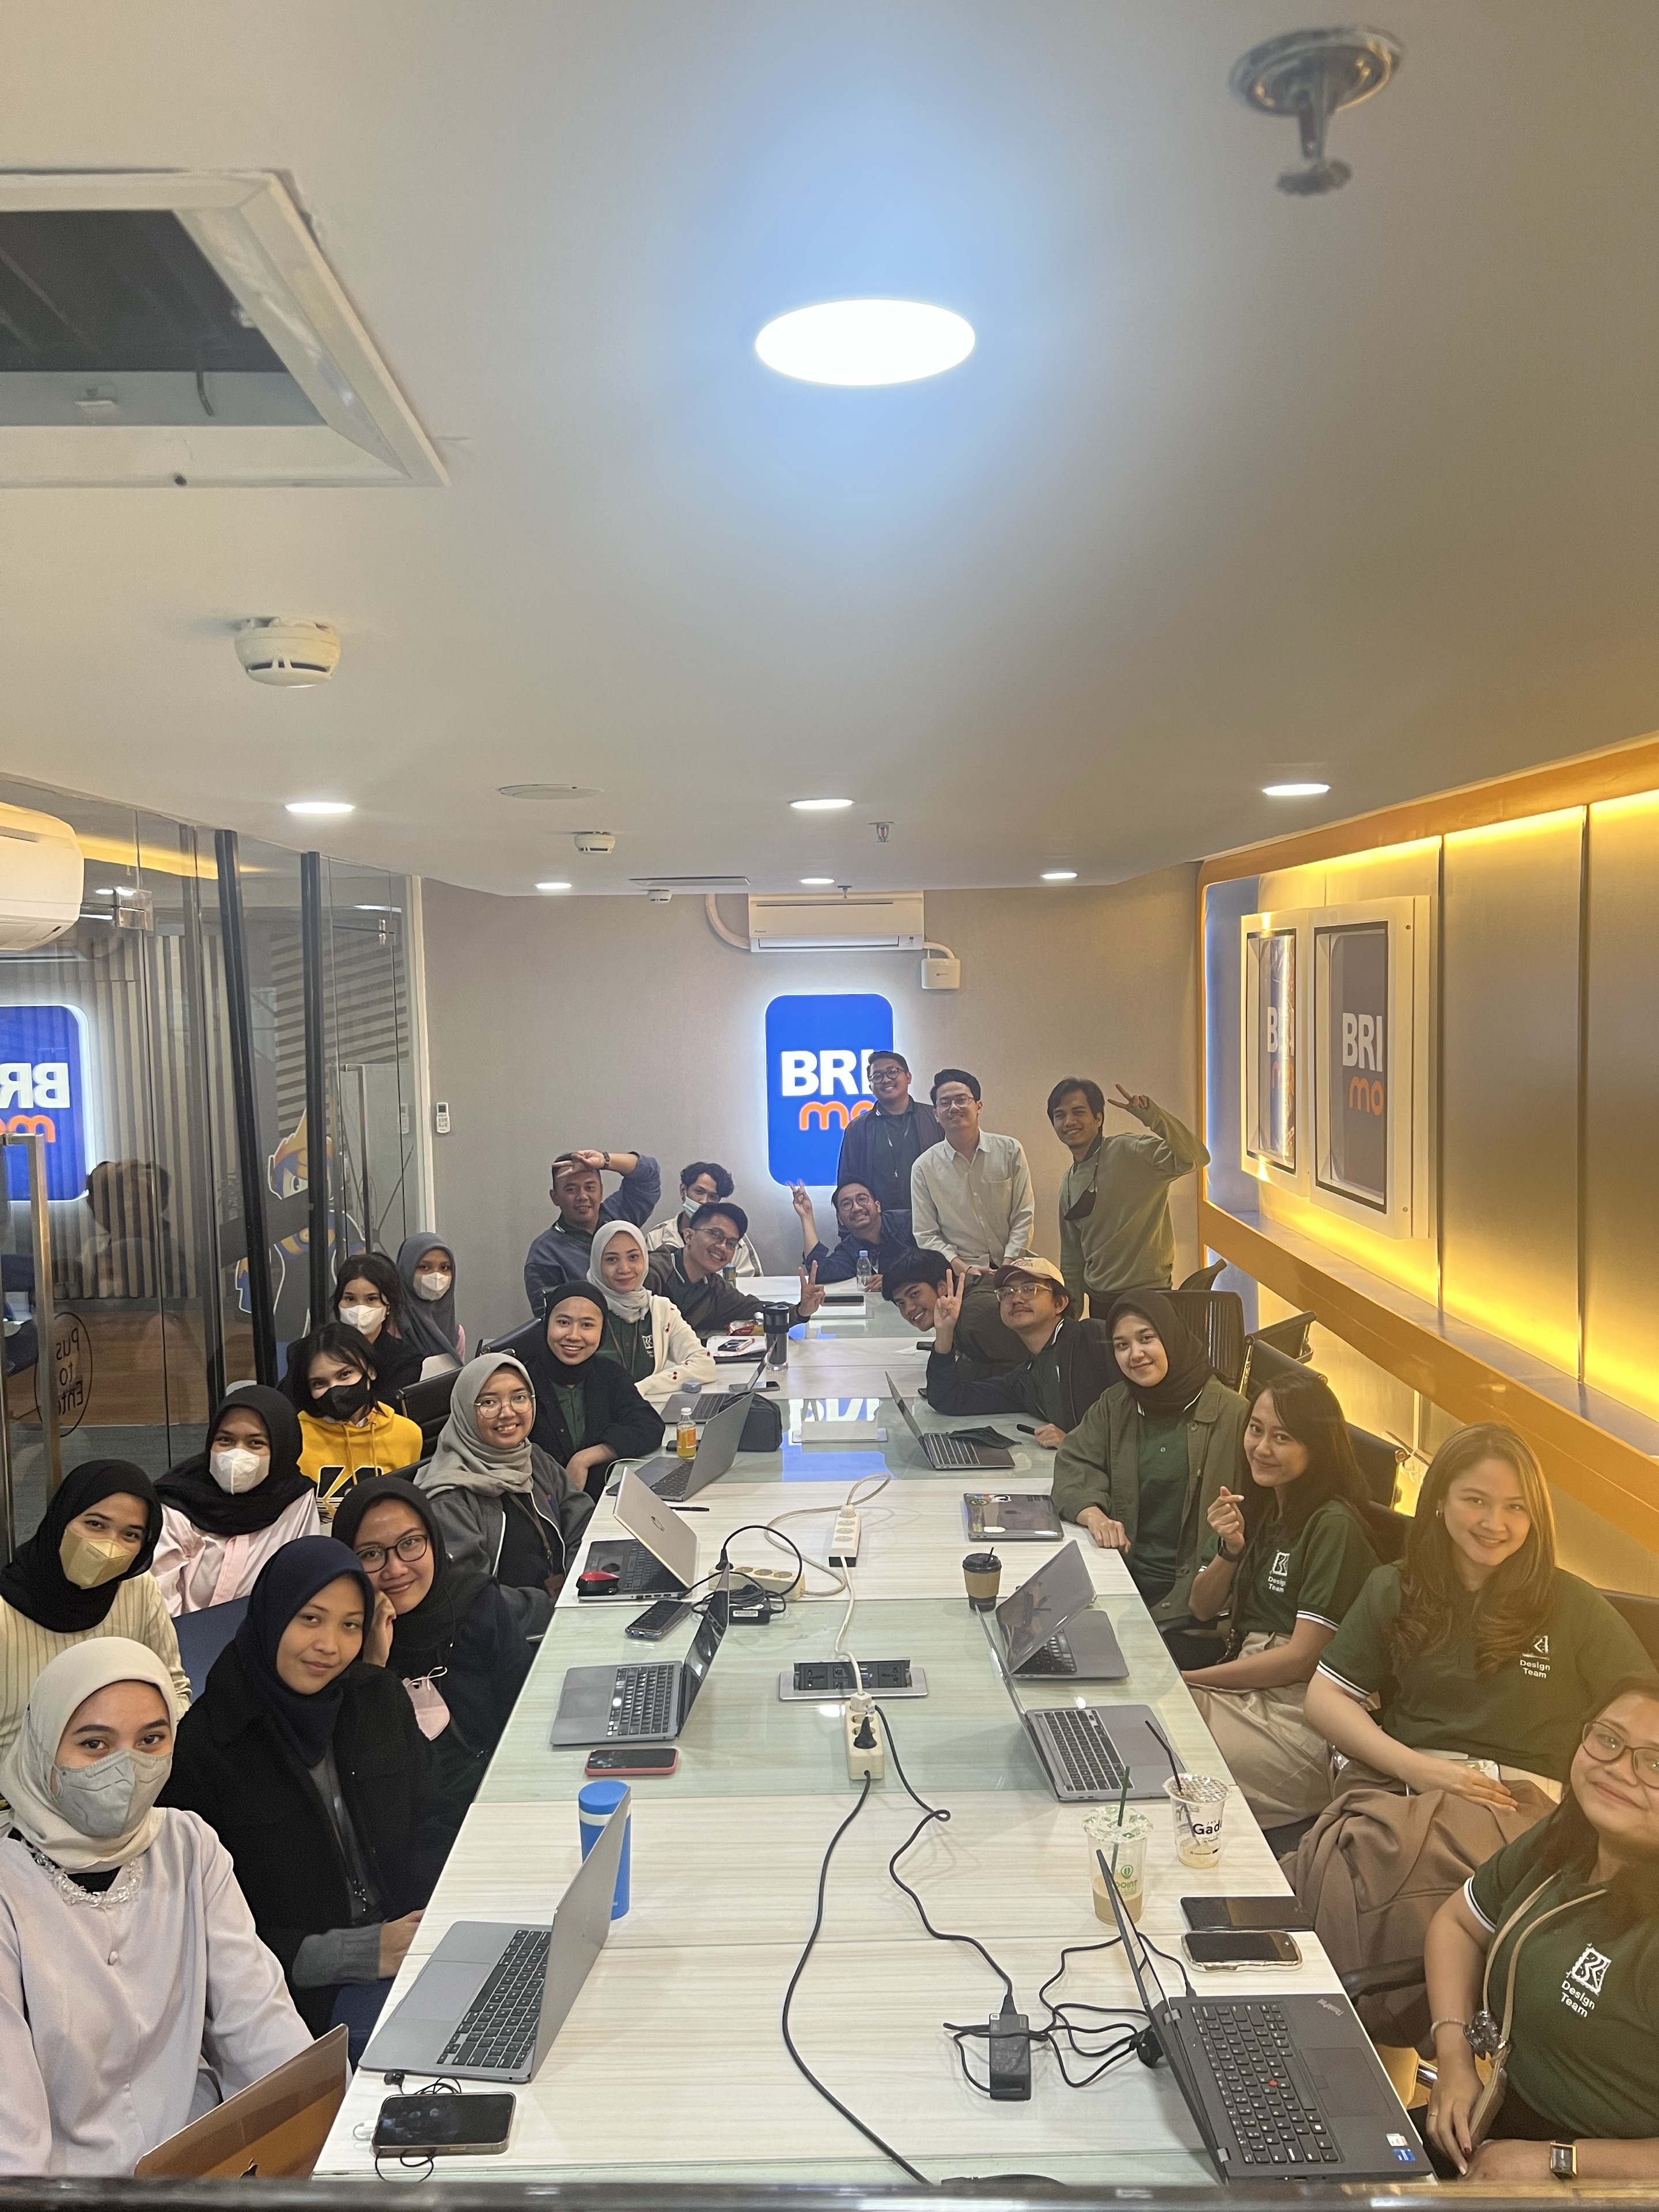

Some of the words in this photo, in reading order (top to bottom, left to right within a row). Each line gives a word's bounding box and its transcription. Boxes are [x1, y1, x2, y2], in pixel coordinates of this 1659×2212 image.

[1342, 1013, 1382, 1072] BRI
[781, 1049, 876, 1096] BRI
[1349, 1076, 1384, 1115] mo
[1268, 1583, 1285, 1593] Team
[1520, 1660, 1550, 1671] Design
[1522, 1667, 1547, 1679] Team
[1560, 1992, 1588, 2017] Team
[1561, 1980, 1595, 2010] Design
